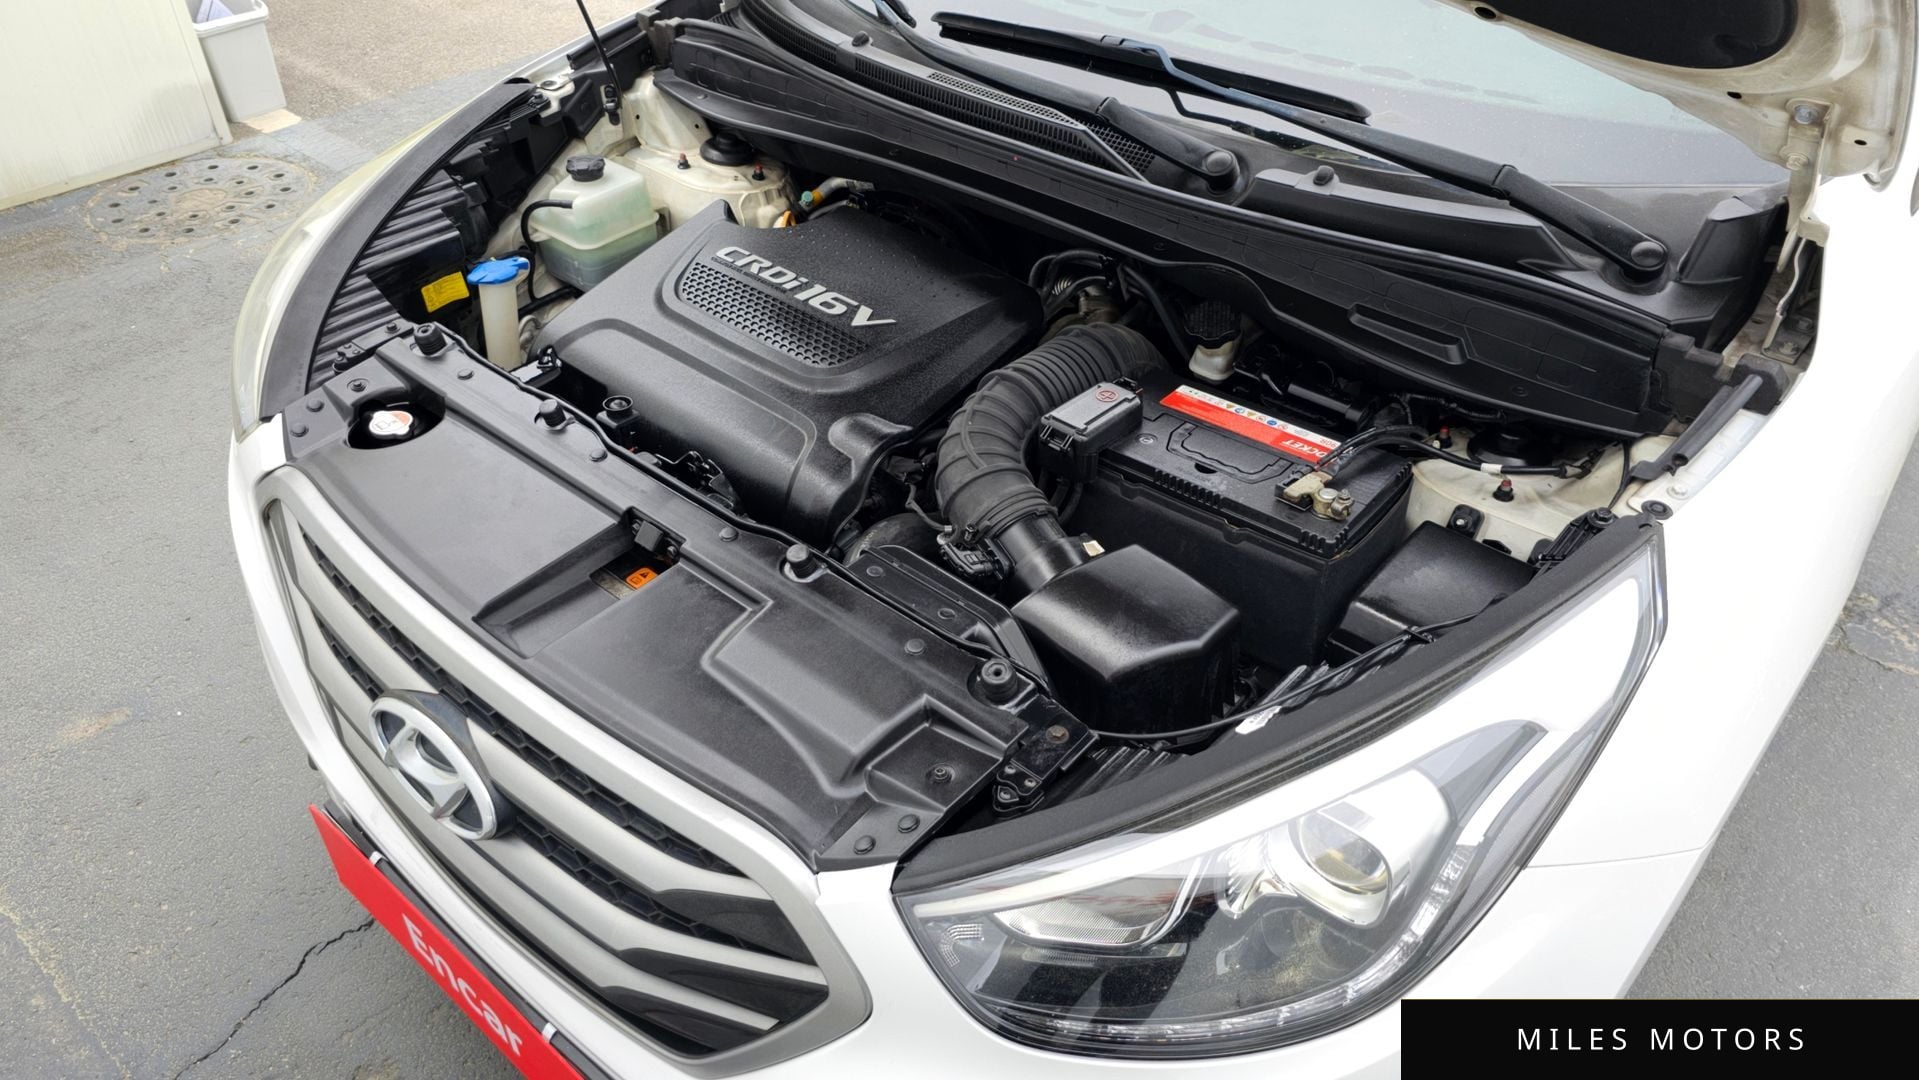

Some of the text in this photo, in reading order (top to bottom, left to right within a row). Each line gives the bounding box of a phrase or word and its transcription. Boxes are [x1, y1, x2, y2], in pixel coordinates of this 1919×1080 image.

[715, 246, 809, 290] CRDi
[794, 283, 897, 327] 16V
[1281, 439, 1328, 458] OCKET
[402, 913, 523, 1057] Encar
